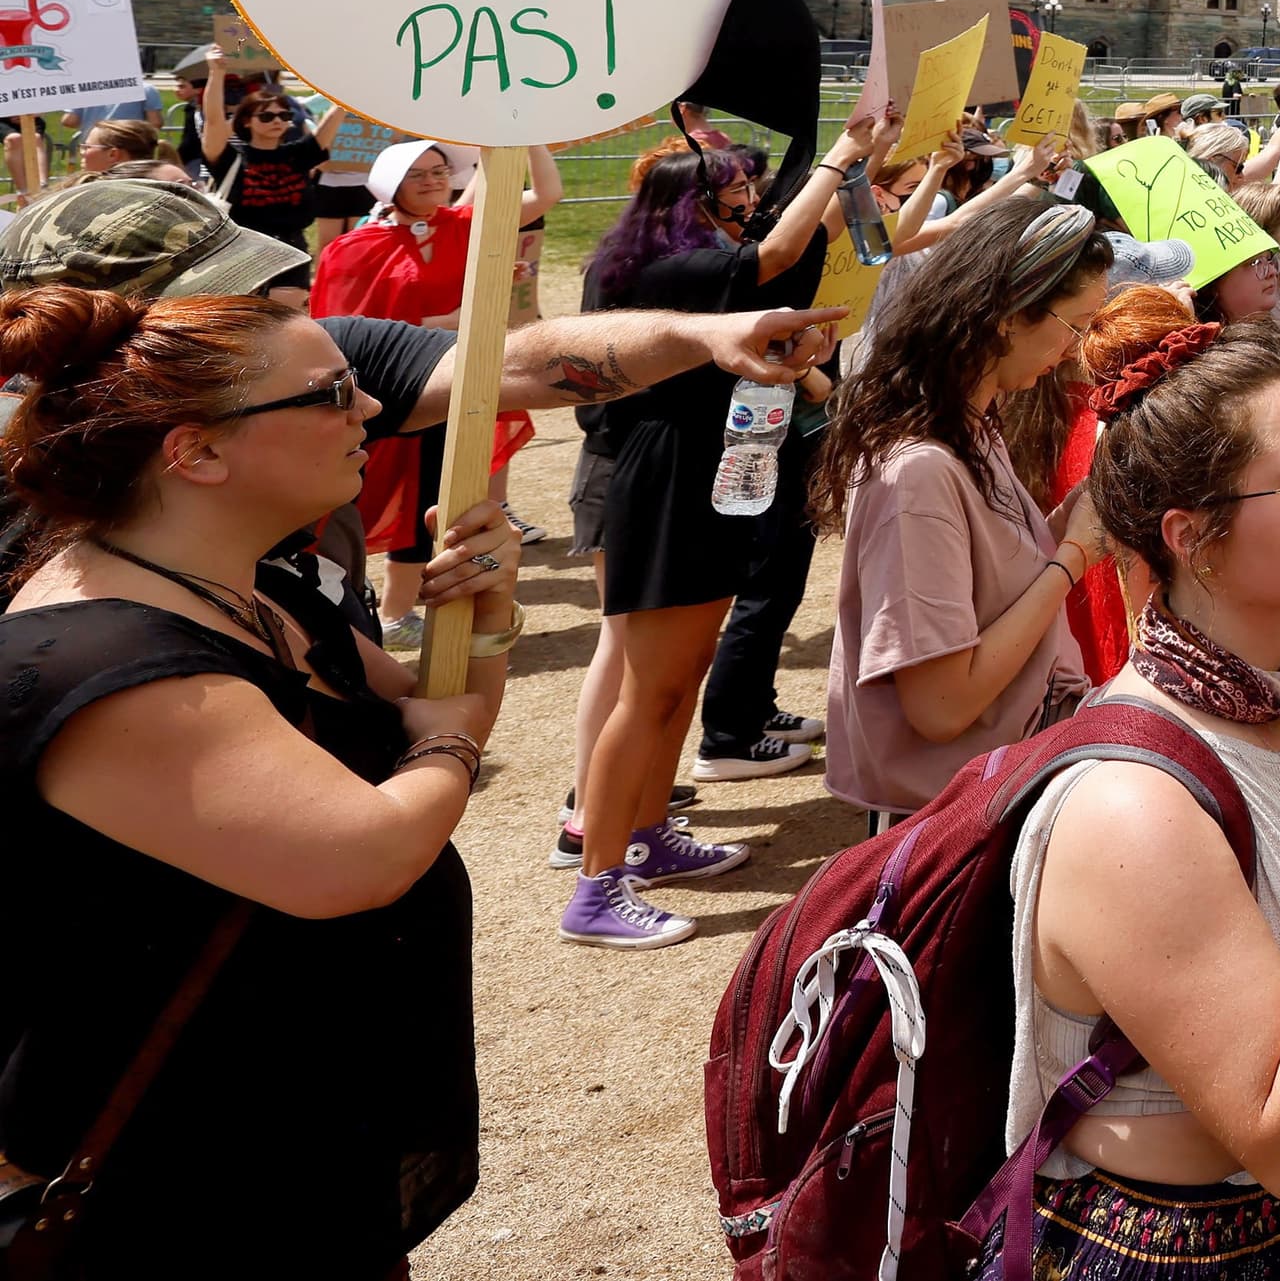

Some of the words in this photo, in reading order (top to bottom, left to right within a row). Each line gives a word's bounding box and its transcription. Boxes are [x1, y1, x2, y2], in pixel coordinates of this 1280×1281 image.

[12, 86, 38, 100] N'EST
[40, 84, 58, 97] PAS
[59, 83, 77, 95] UNE
[78, 77, 139, 92] MARCHANDISE
[1176, 210, 1207, 232] TO
